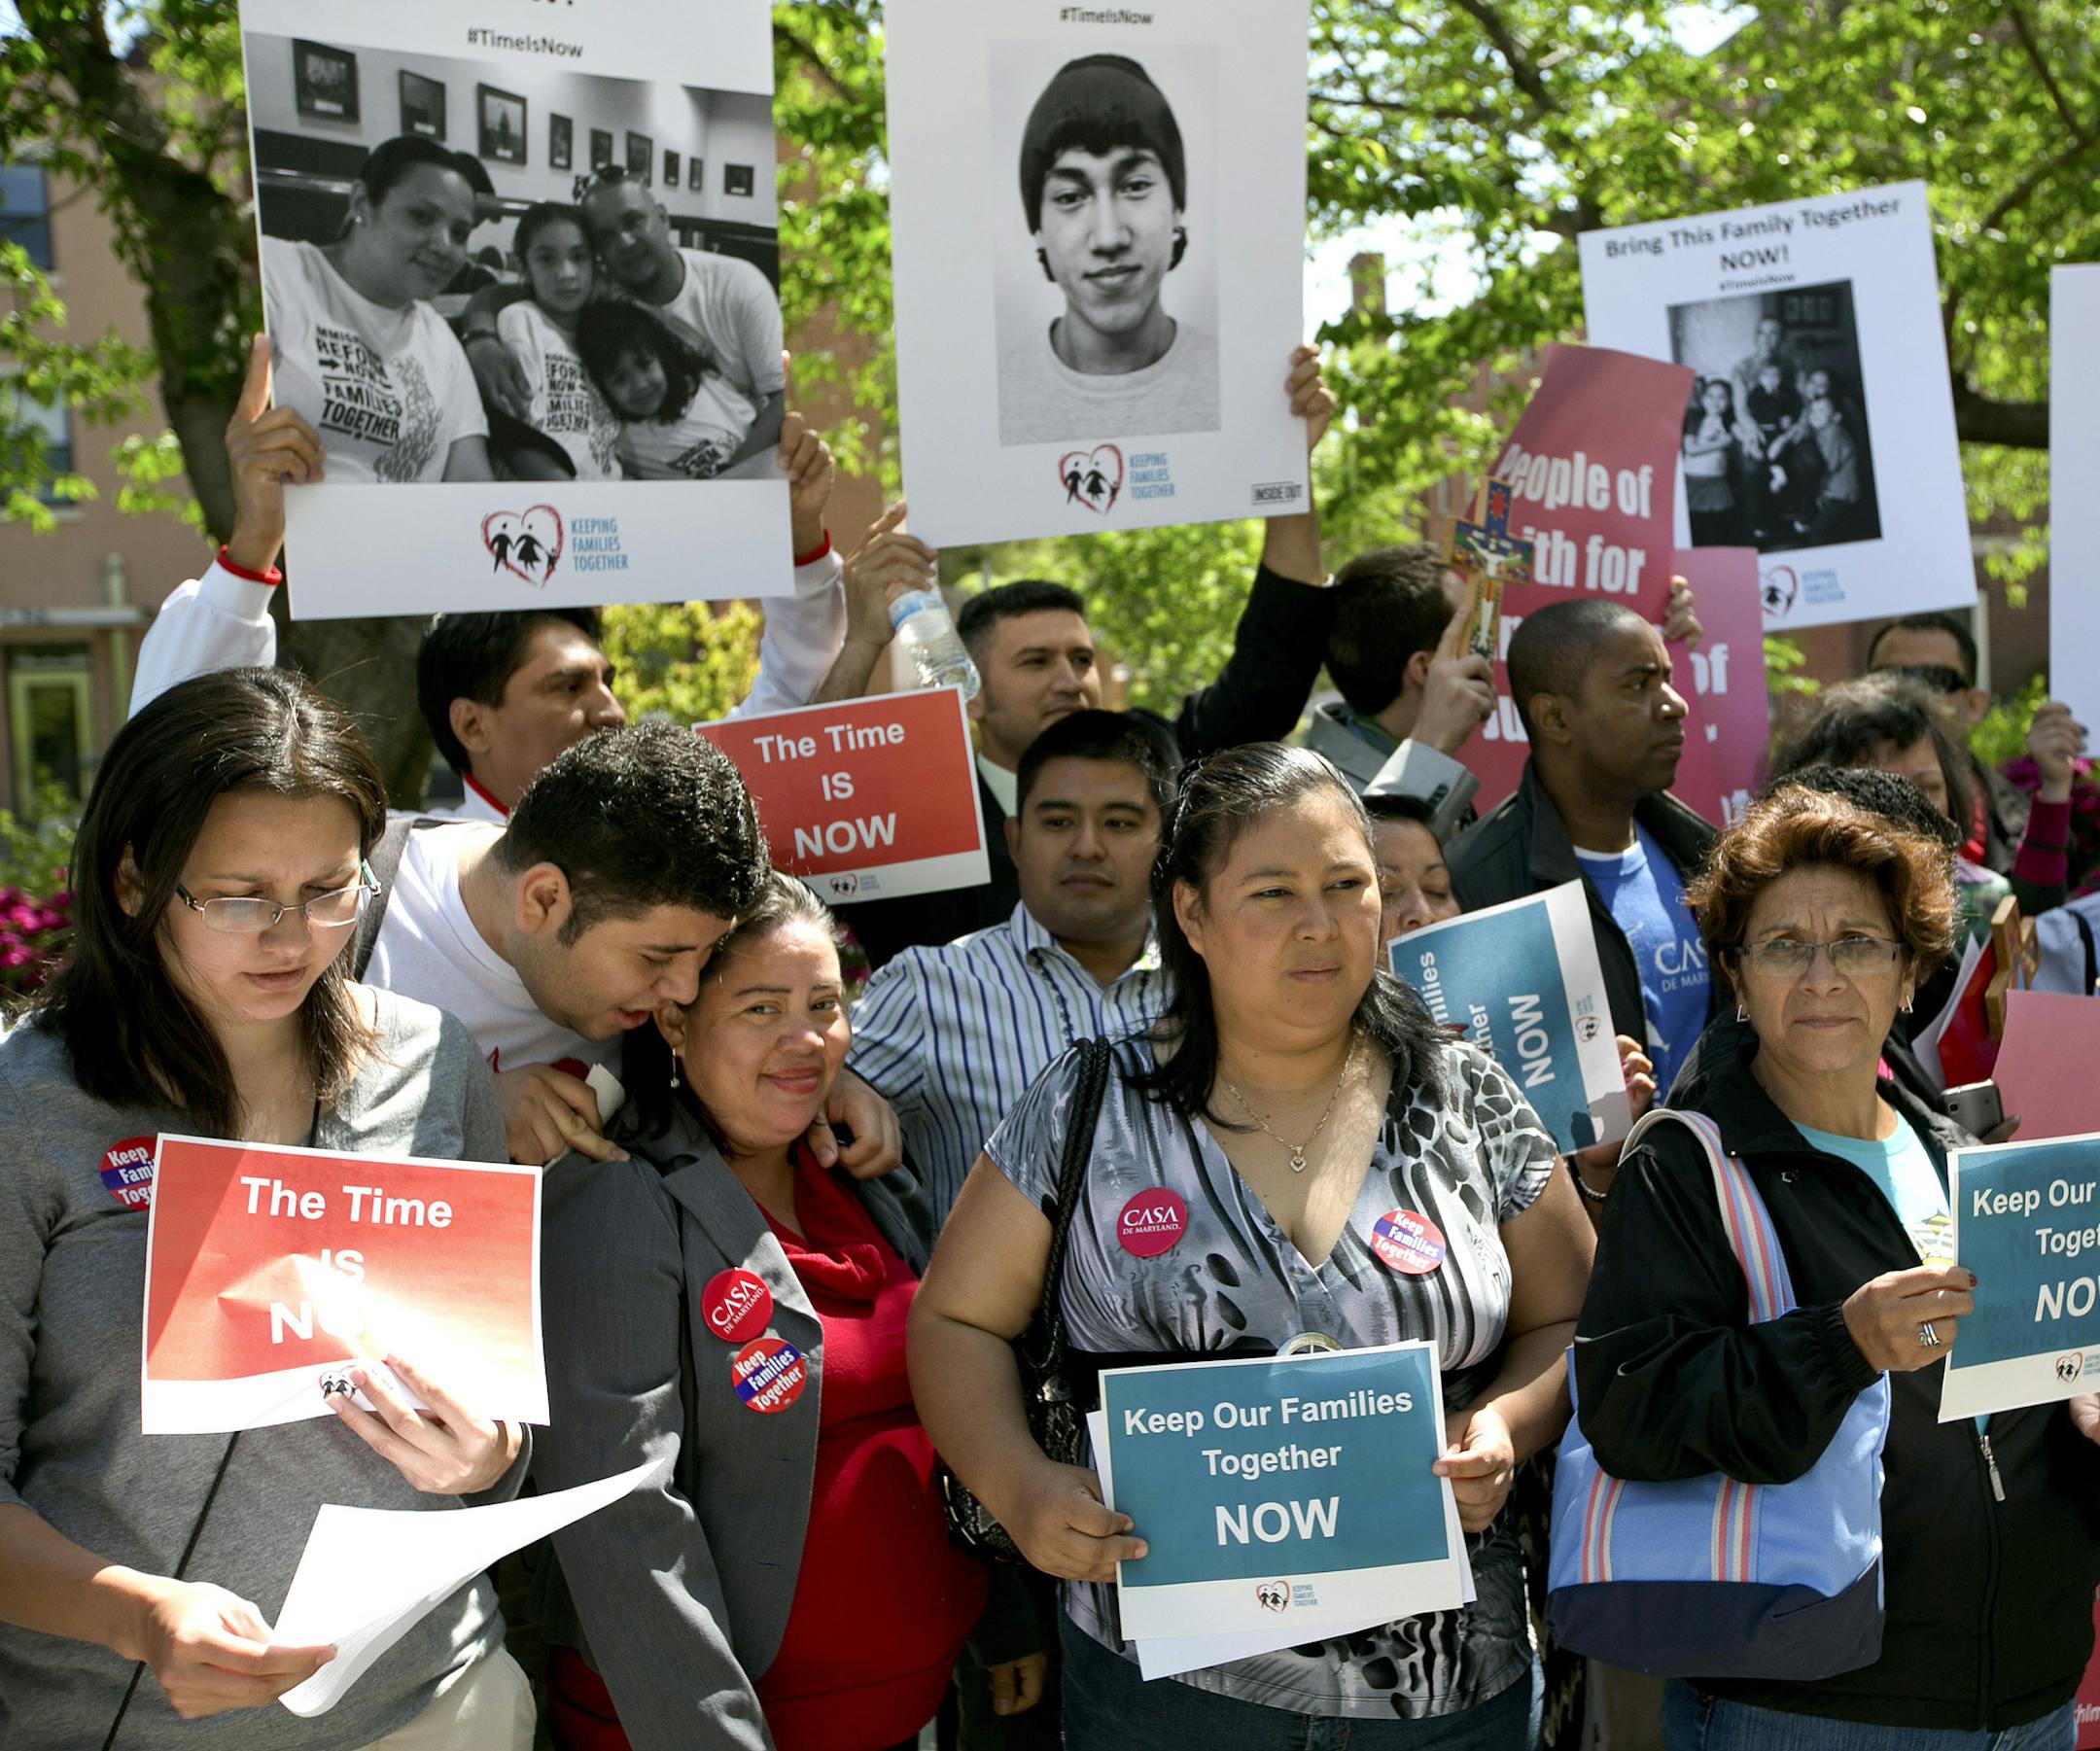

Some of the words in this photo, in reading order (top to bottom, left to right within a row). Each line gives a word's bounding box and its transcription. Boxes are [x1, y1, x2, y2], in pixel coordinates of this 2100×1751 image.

[1059, 6, 1154, 25] #TimeIsNow
[467, 27, 584, 58] #TimeIsNow
[1605, 236, 1663, 259] Bring
[1669, 224, 1715, 249] This
[1720, 212, 1794, 242] Family
[1802, 196, 1902, 228] Together
[1720, 242, 1790, 271] NOW!
[322, 399, 401, 440] TOGETHER
[1131, 482, 1175, 501] TOGETHER
[1495, 443, 1611, 511] People
[1616, 464, 1654, 520] of
[571, 516, 618, 535] KEEPING
[572, 536, 621, 553] FAMILIES
[574, 553, 629, 573] TOGETHER
[1585, 535, 1646, 596] for
[753, 734, 818, 764] The
[823, 722, 905, 754] Time
[821, 771, 855, 802] IS
[793, 812, 896, 859] NOW
[1655, 937, 1708, 975] CAS
[1662, 978, 1679, 993] DE
[1508, 994, 1556, 1090] NOW
[107, 1146, 149, 1168] Keep
[240, 1175, 326, 1220] The
[342, 1185, 452, 1228] Time
[1123, 1206, 1178, 1227] CASA
[1973, 1188, 2042, 1218] Keep
[2048, 1178, 2097, 1208] Our
[1388, 1225, 1439, 1257] Families
[1393, 1211, 1424, 1237] Keep
[1375, 1236, 1431, 1269] Together
[712, 1279, 758, 1326] CASA
[2034, 1276, 2100, 1323] NO
[723, 1322, 735, 1334] DE
[735, 1349, 767, 1378] Keep
[747, 1349, 795, 1391] Families
[752, 1366, 804, 1411] Together
[1124, 1408, 1205, 1438] Keep
[1213, 1401, 1272, 1430] Our
[1280, 1390, 1414, 1424] Families
[1202, 1444, 1343, 1481] Together
[1215, 1496, 1341, 1546] NOW
